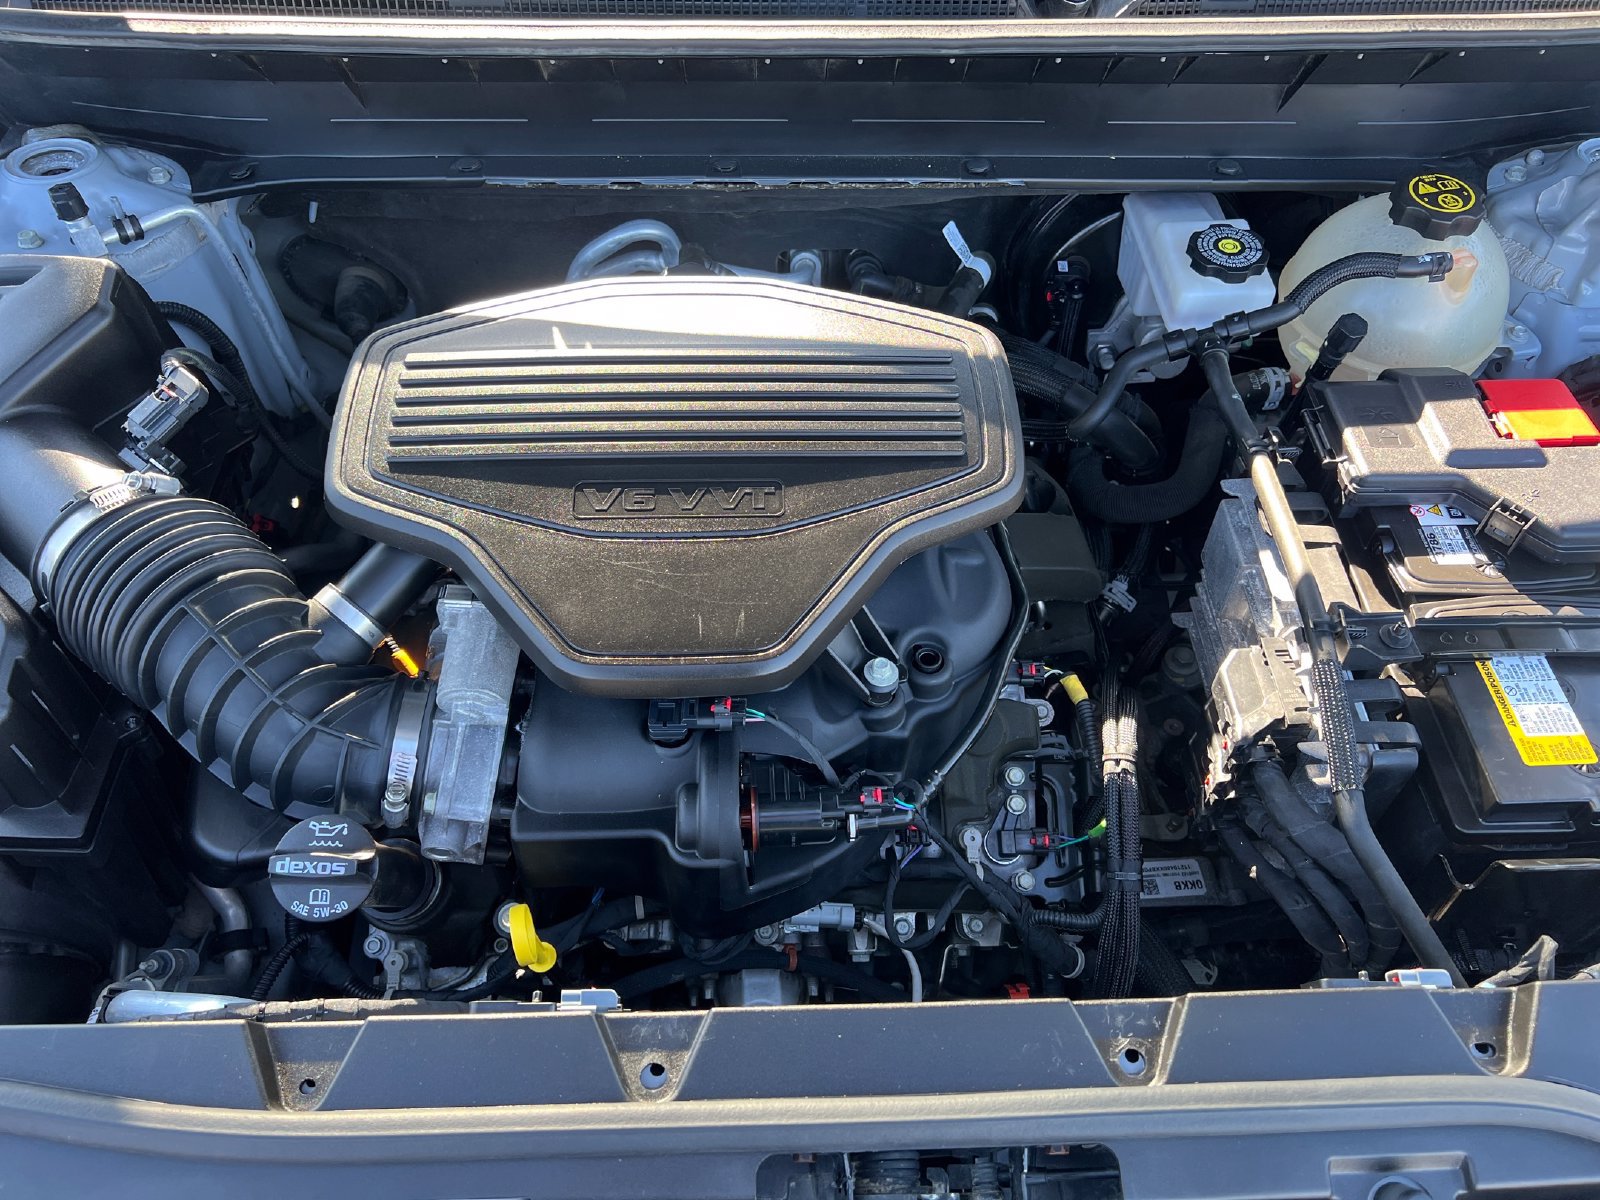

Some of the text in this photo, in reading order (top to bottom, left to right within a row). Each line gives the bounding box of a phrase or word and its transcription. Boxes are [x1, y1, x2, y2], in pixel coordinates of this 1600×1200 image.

[582, 486, 775, 512] V6 VVT
[1479, 660, 1513, 719] DANGER/POISON
[275, 857, 346, 875] dexos
[290, 900, 349, 918] SAE 5W-30
